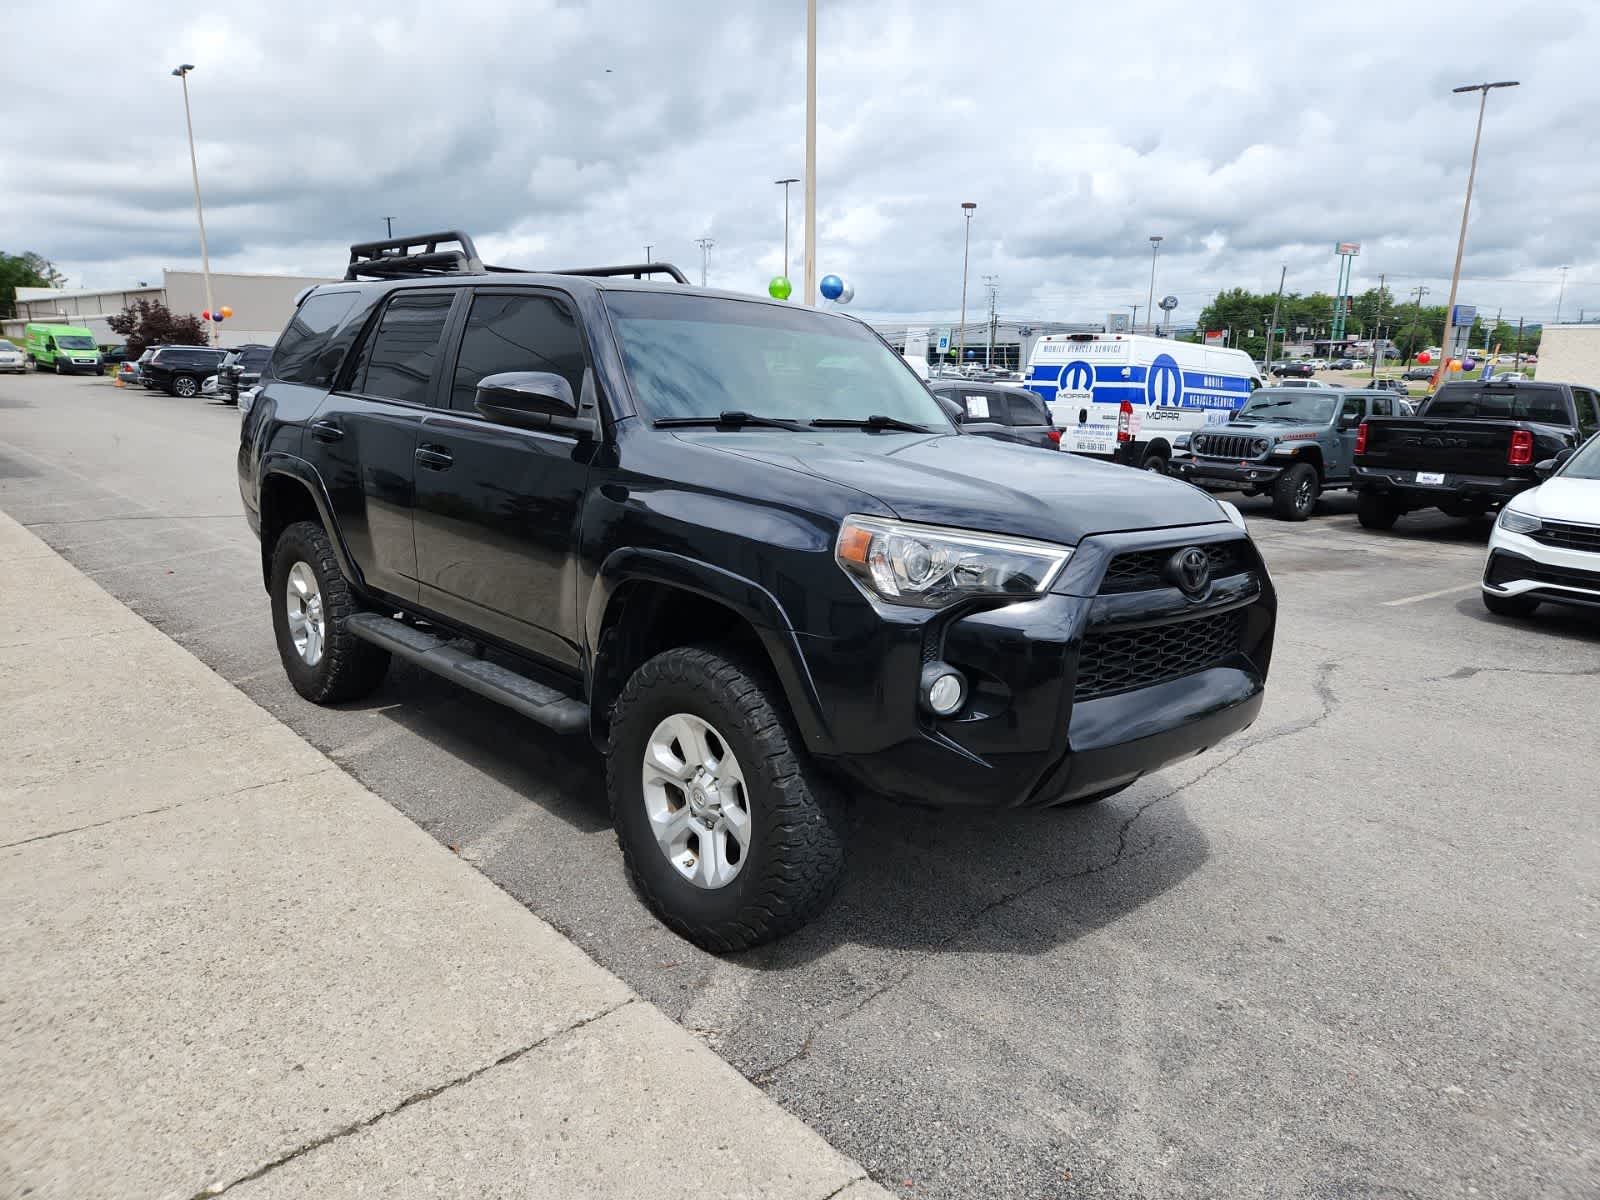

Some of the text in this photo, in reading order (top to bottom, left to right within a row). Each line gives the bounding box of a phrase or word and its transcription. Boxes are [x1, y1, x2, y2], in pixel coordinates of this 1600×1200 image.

[1043, 343, 1121, 353] MOBILE VEHICLE SERVICE
[1203, 376, 1224, 388] MOBILE
[1189, 394, 1236, 408] VEHICLE SERVICE
[1146, 411, 1180, 422] MOPAR
